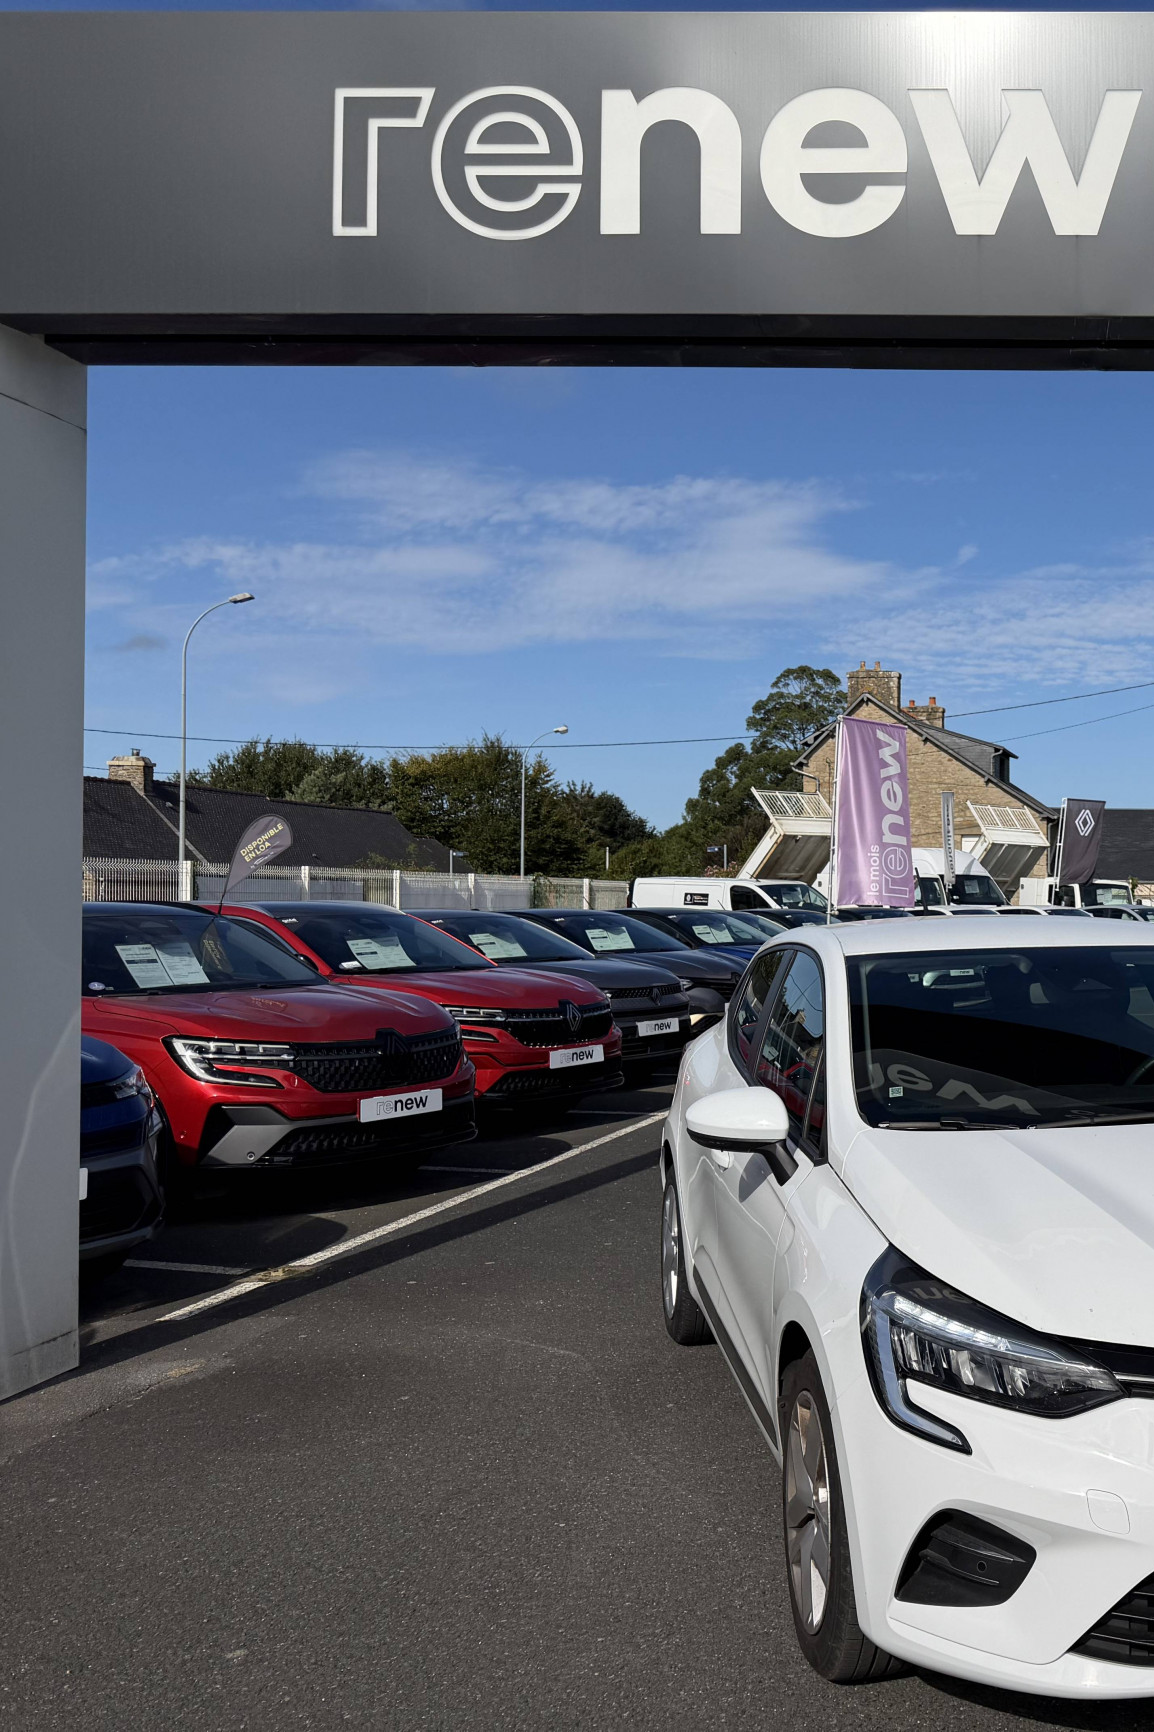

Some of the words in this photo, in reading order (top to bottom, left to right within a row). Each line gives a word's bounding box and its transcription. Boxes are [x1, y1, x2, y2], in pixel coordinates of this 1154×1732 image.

[332, 85, 1143, 241] renew
[876, 729, 909, 898] renew
[240, 823, 284, 856] DISPONIBLE
[244, 851, 256, 863] EN
[255, 841, 271, 855] LOA
[868, 844, 880, 882] mois
[867, 883, 879, 896] le
[560, 1050, 594, 1064] renew
[377, 1095, 428, 1116] renew
